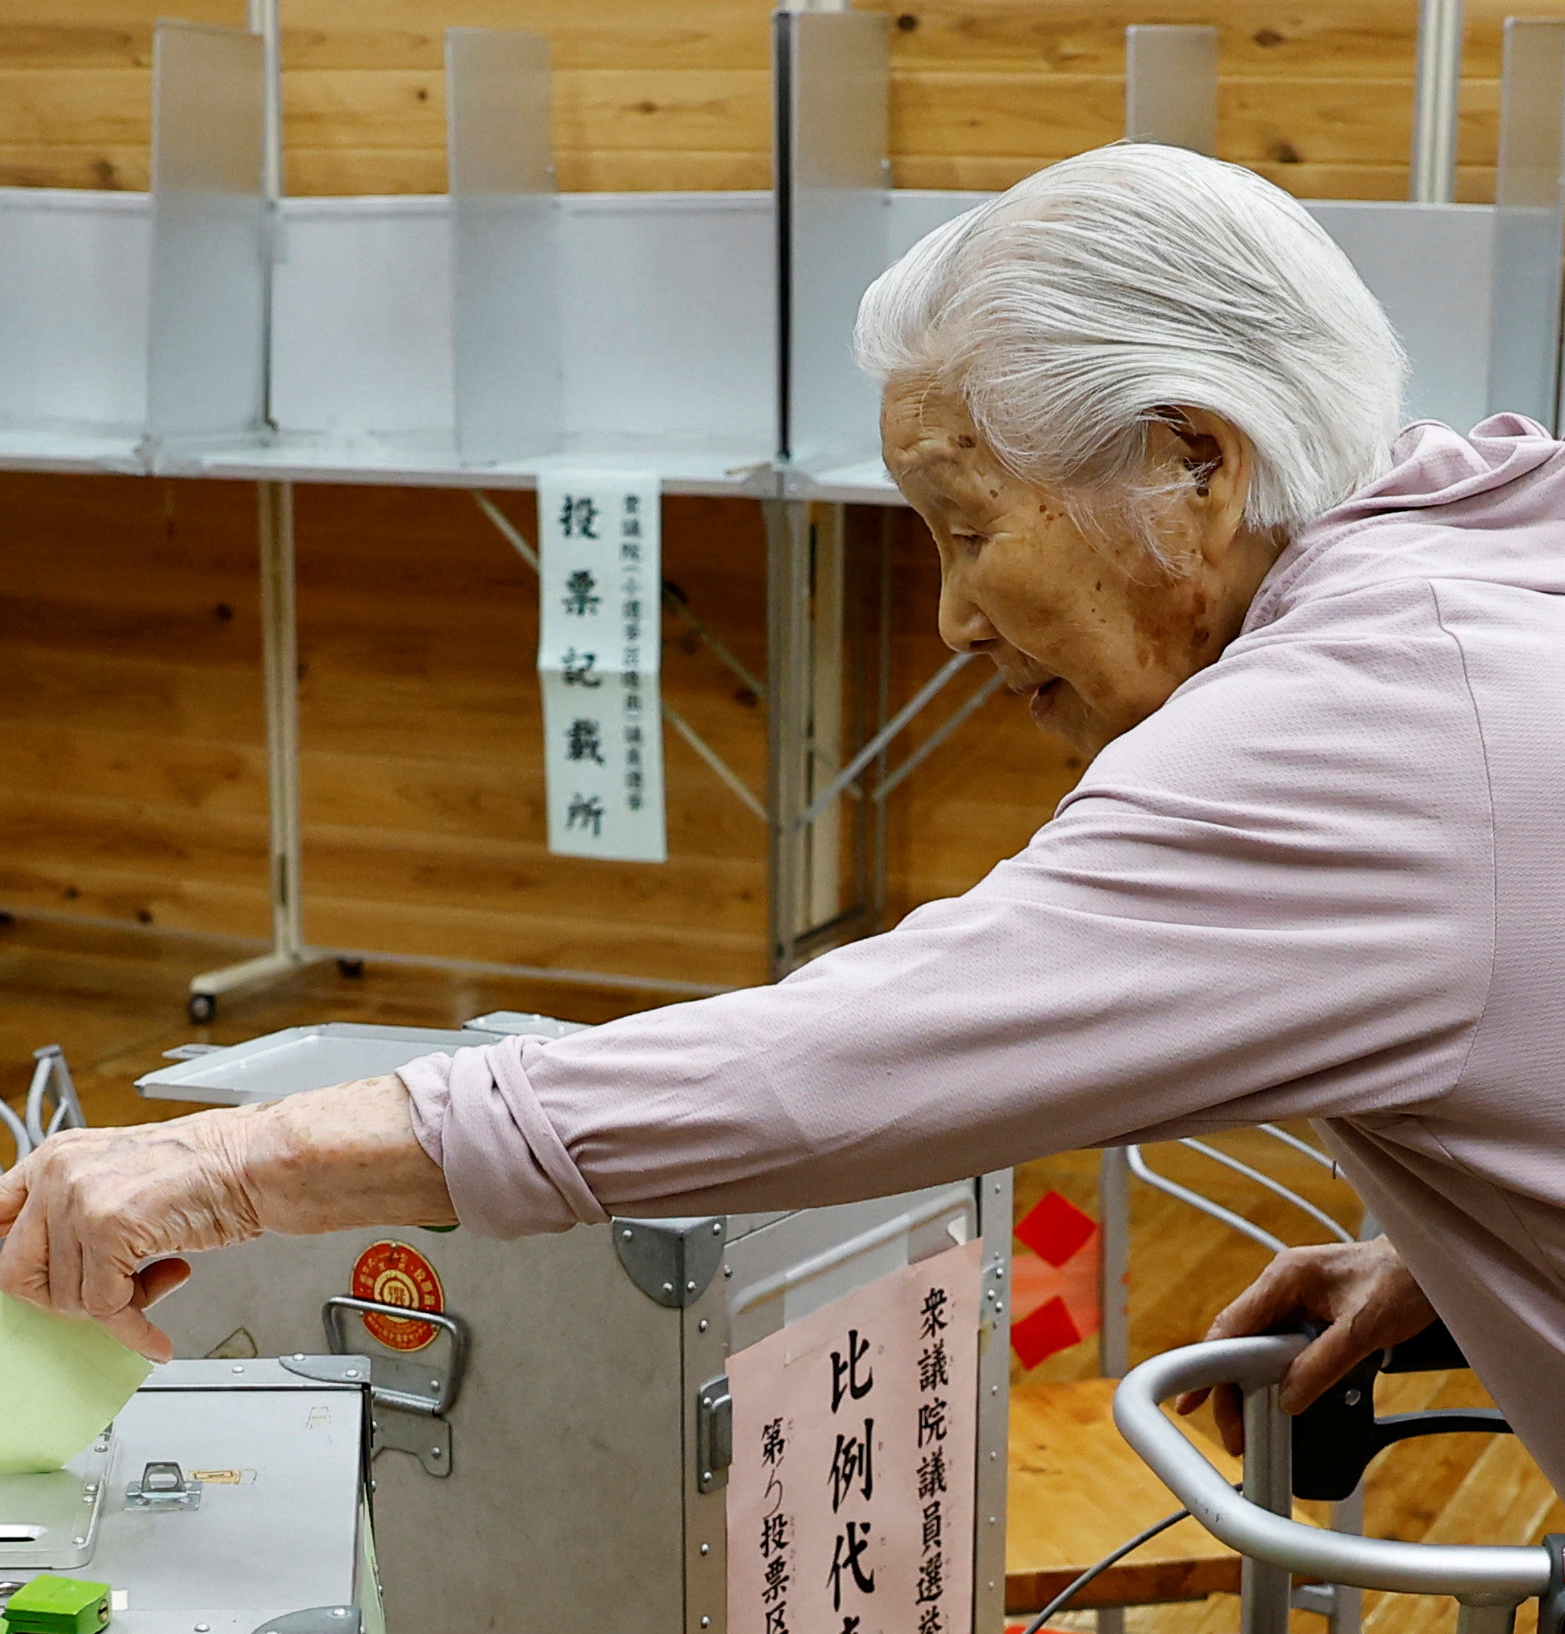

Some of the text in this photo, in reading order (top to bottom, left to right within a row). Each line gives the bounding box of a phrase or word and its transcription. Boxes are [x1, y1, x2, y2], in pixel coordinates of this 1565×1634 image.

[559, 493, 607, 839] 投票記載所
